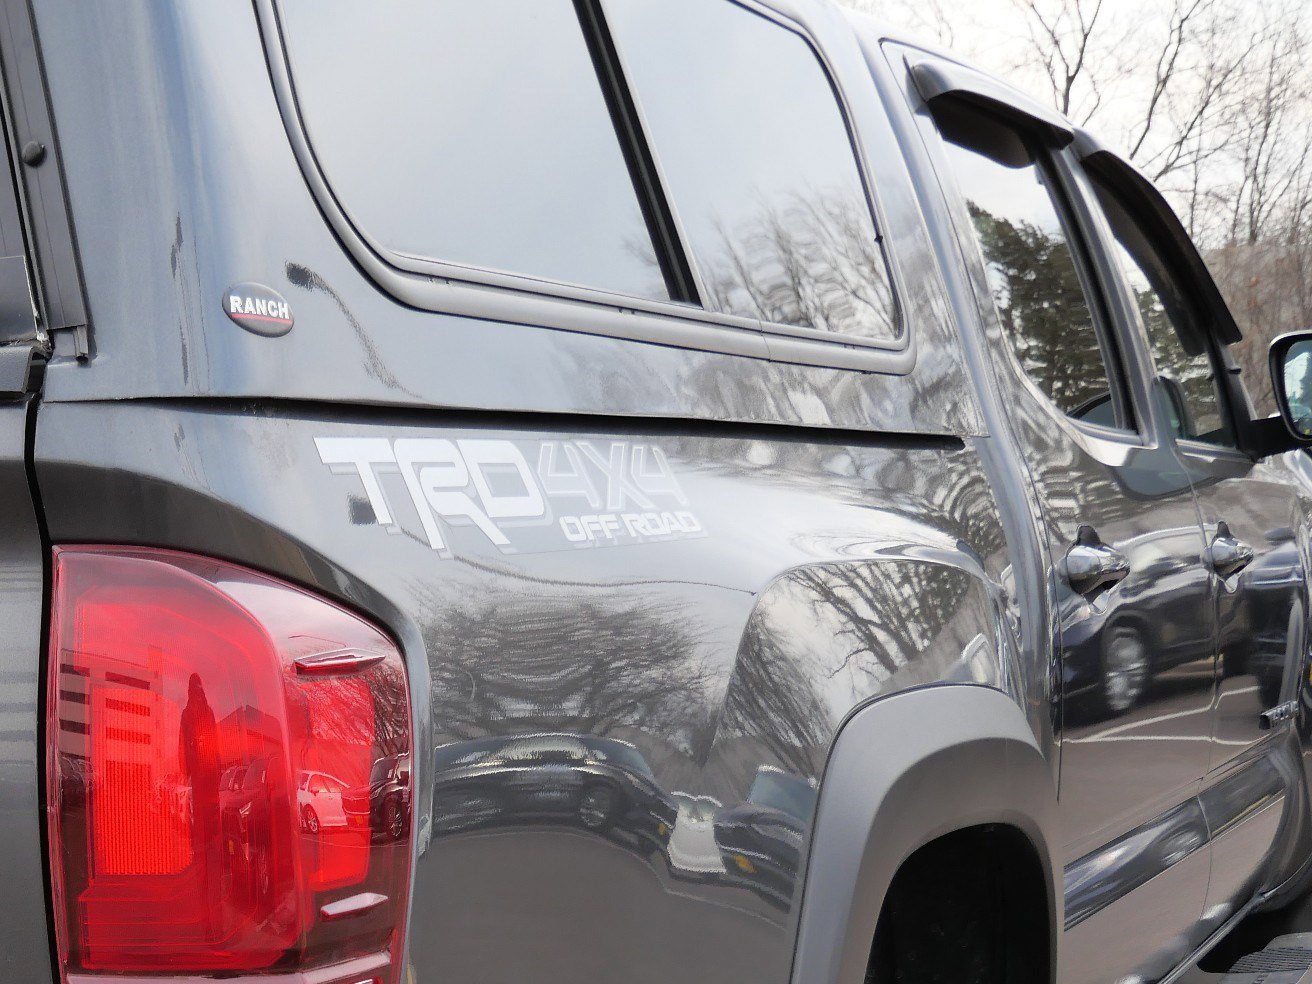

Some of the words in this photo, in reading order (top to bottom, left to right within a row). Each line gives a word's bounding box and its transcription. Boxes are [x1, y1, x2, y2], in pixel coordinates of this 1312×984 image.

[229, 295, 290, 320] RANCH
[313, 436, 546, 550] TRD
[559, 514, 620, 542] OFF
[626, 510, 703, 538] ROAD
